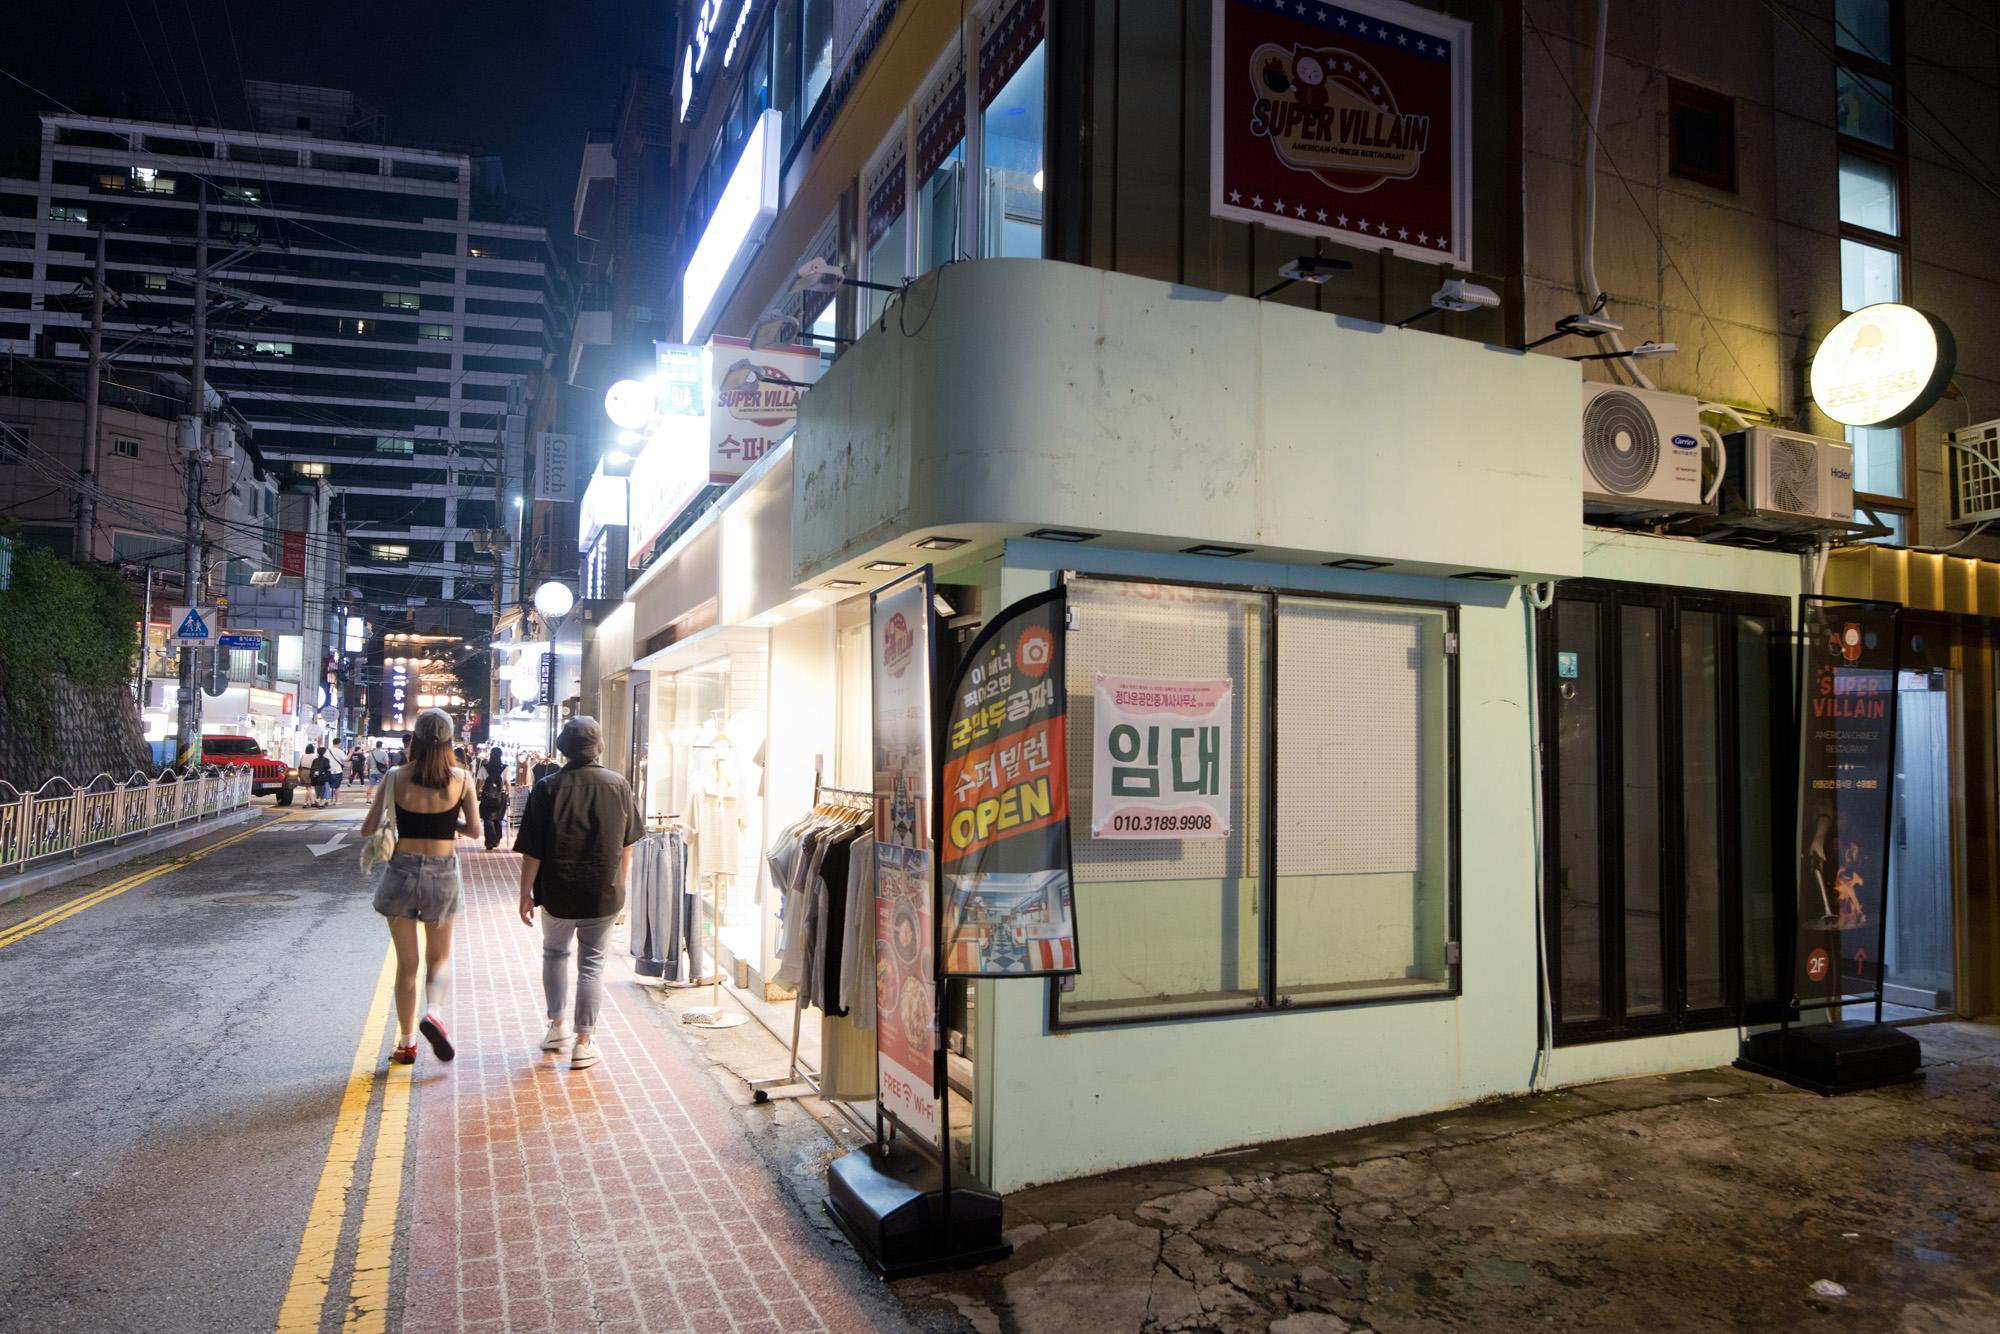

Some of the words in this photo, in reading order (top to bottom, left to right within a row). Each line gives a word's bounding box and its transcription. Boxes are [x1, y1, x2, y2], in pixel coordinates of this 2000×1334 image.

[1252, 98, 1335, 142] SUPER
[1339, 108, 1429, 152] VILLAIN
[1291, 143, 1330, 154] AMERICAN
[1331, 147, 1360, 157] CHINESE
[1361, 150, 1406, 161] RESTAURANT
[717, 390, 762, 408] SUPER
[1861, 403, 1882, 421] 3F
[1674, 437, 1695, 446] Carrier
[551, 439, 568, 493] Glitch
[1831, 467, 1851, 480] Haier
[971, 665, 987, 685] 이
[988, 652, 1012, 676] 배너
[964, 673, 1012, 707] 찍어오면
[1816, 676, 1879, 697] SUPER
[1115, 690, 1197, 708] 정다운공인중개사사무소
[1813, 698, 1885, 719] VILLAIN
[1815, 730, 1852, 740] AMERICAN
[1852, 731, 1879, 741] CHINESE
[1826, 744, 1868, 754] RESTAURANT
[1108, 723, 1221, 798] 임대
[950, 776, 1052, 851] OPEN
[1113, 814, 1212, 832] 010.3189.9908
[1809, 957, 1825, 974] 2F
[883, 1071, 902, 1099] FREE
[914, 1092, 934, 1123] Wi-Fi
